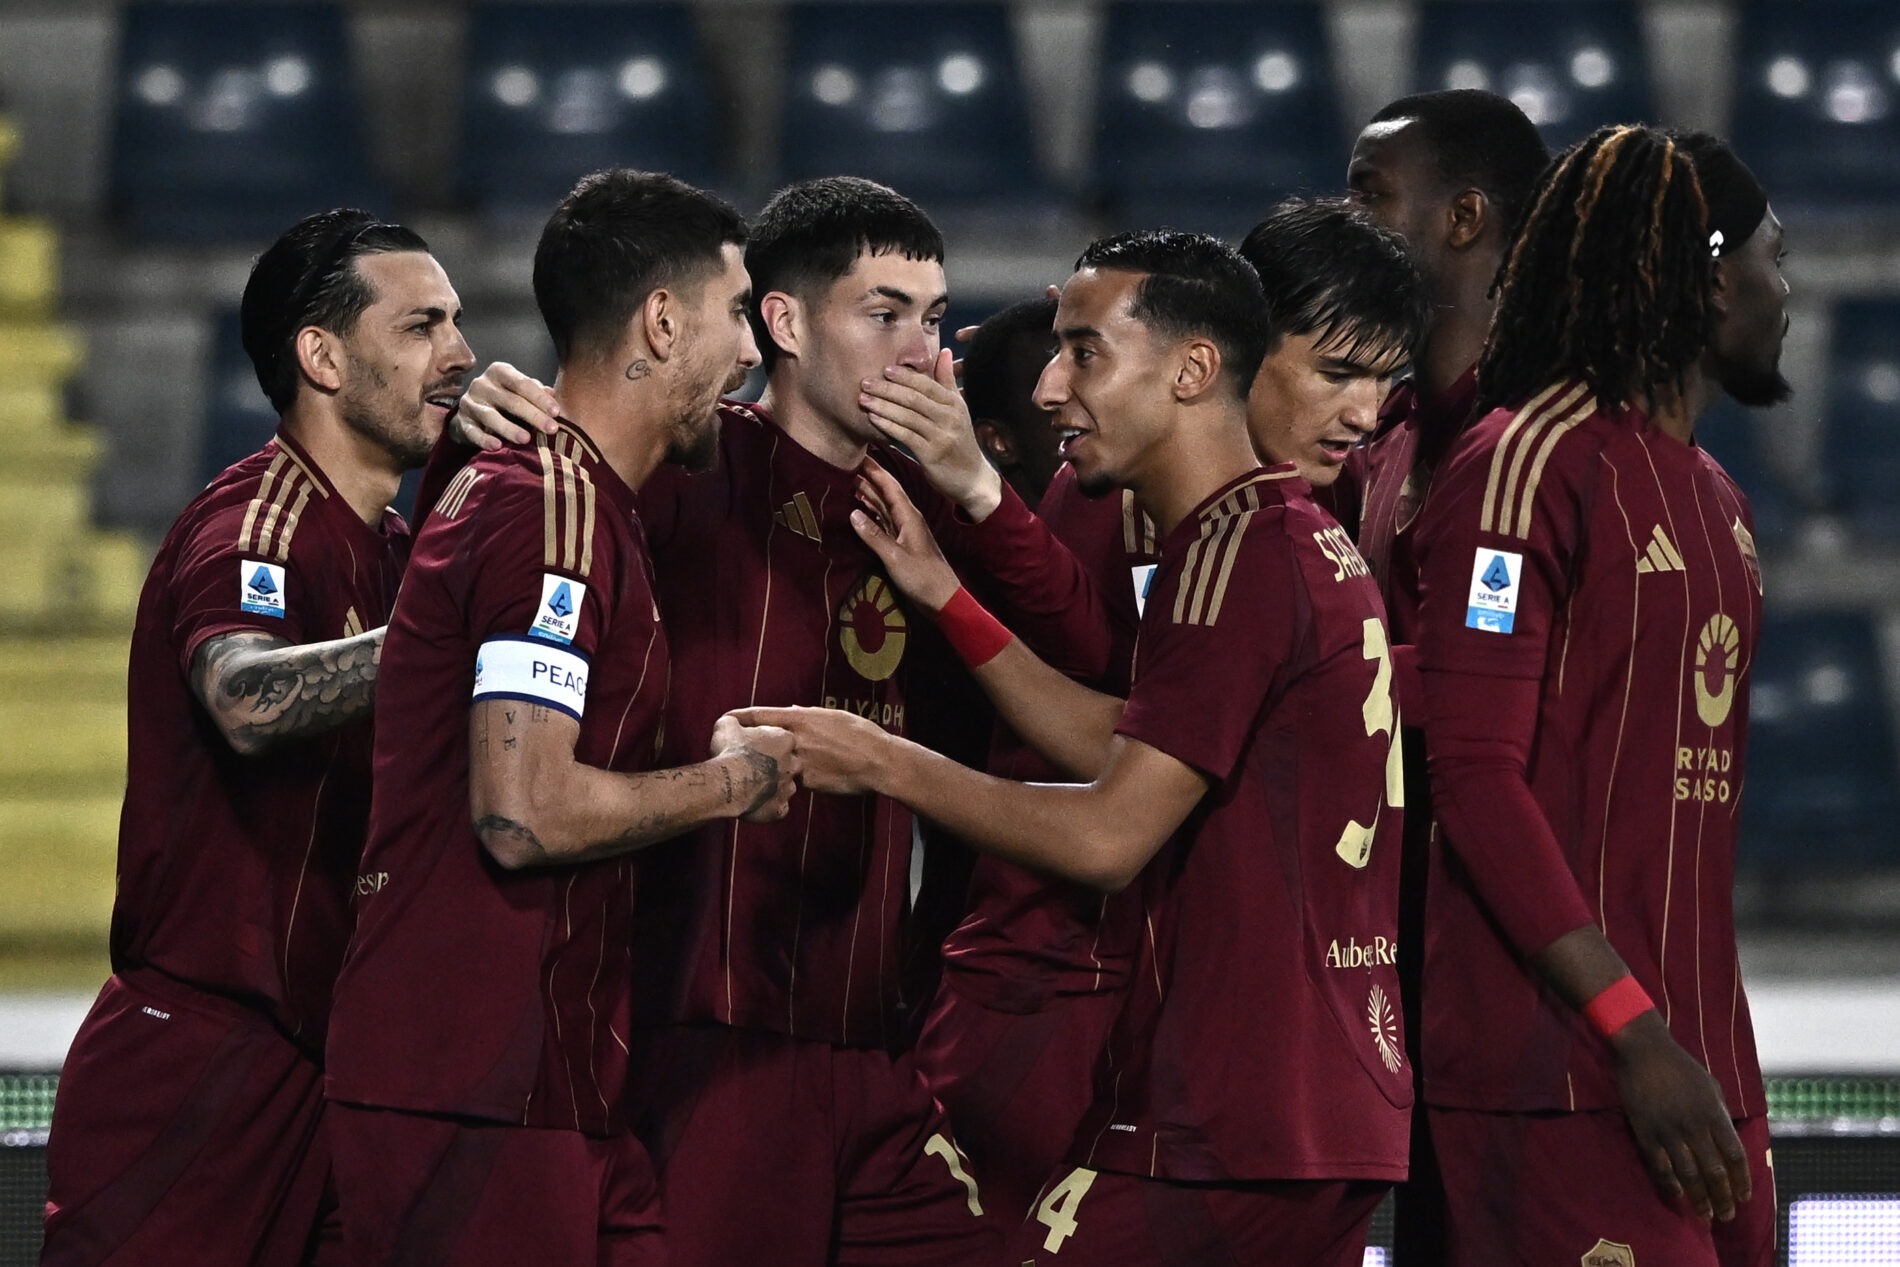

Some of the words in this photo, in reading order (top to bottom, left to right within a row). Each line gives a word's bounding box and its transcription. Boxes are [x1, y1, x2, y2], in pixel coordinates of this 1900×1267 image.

[247, 592, 271, 602] SERIE
[1477, 592, 1501, 603] SERIE
[541, 615, 565, 629] SERIE
[532, 660, 587, 697] PEAC
[1677, 746, 1732, 773] RYAD
